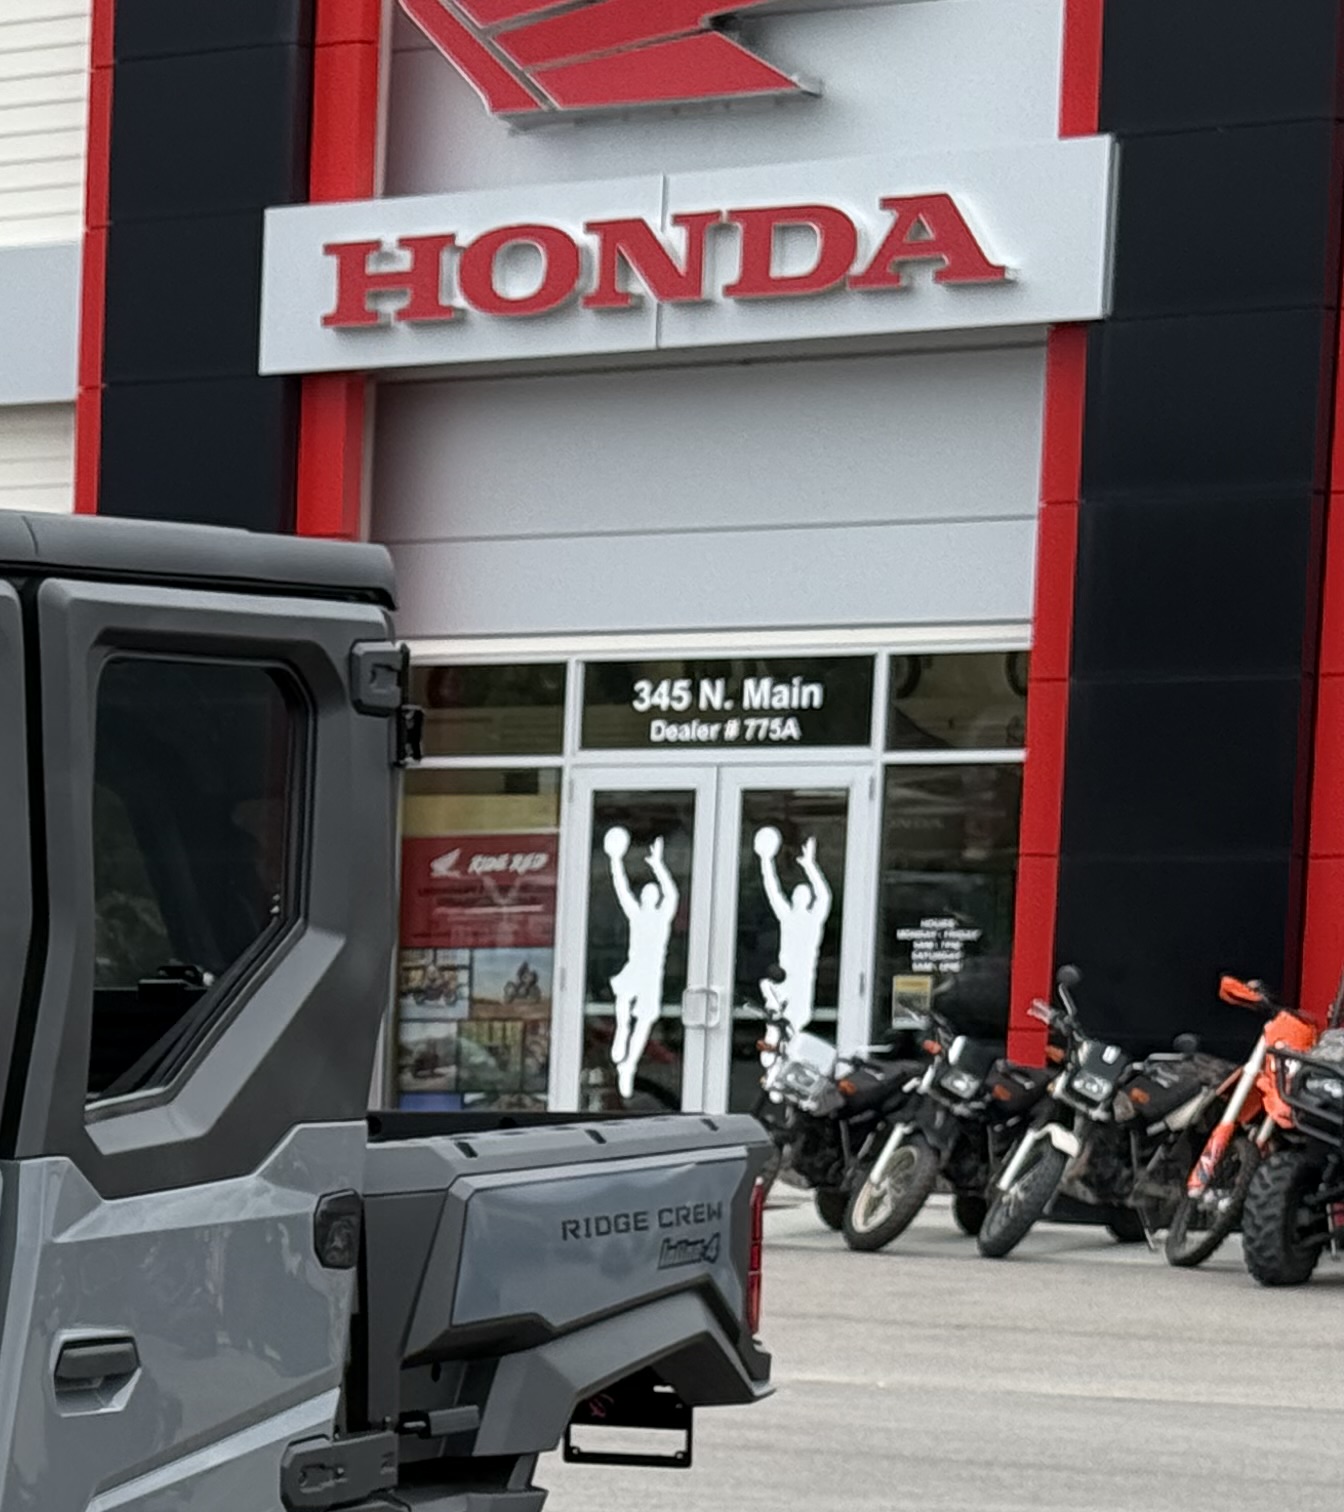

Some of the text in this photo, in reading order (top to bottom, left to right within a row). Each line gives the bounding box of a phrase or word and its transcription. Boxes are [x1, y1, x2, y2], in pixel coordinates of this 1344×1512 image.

[321, 192, 1014, 328] HONDA
[632, 675, 824, 712] 345 N. Main
[649, 716, 802, 742] Dealer # 775A
[561, 1201, 724, 1241] RIDGE CREW
